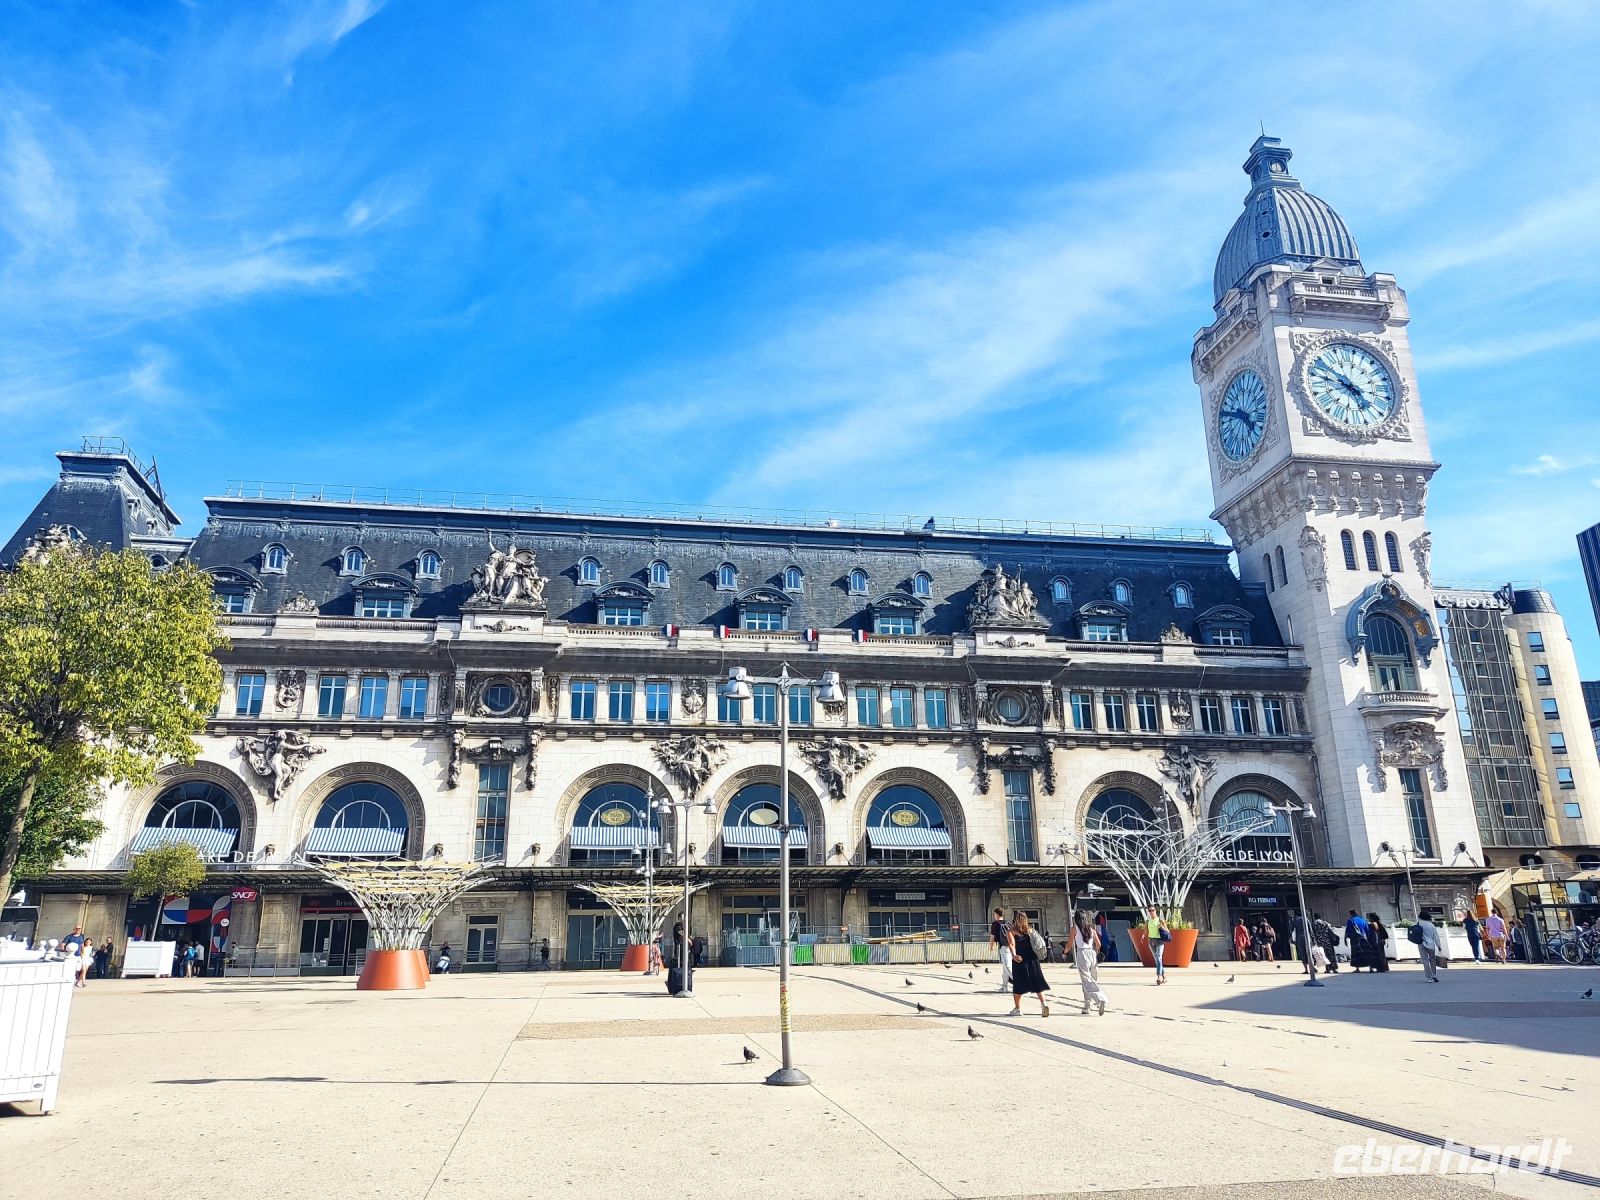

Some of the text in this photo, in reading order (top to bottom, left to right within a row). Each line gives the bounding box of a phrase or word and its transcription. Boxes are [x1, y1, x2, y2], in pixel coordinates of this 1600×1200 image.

[234, 851, 254, 863] DE
[1199, 850, 1294, 861] GARE DE LYON
[1231, 885, 1250, 893] SNCF
[231, 891, 254, 899] SNCF
